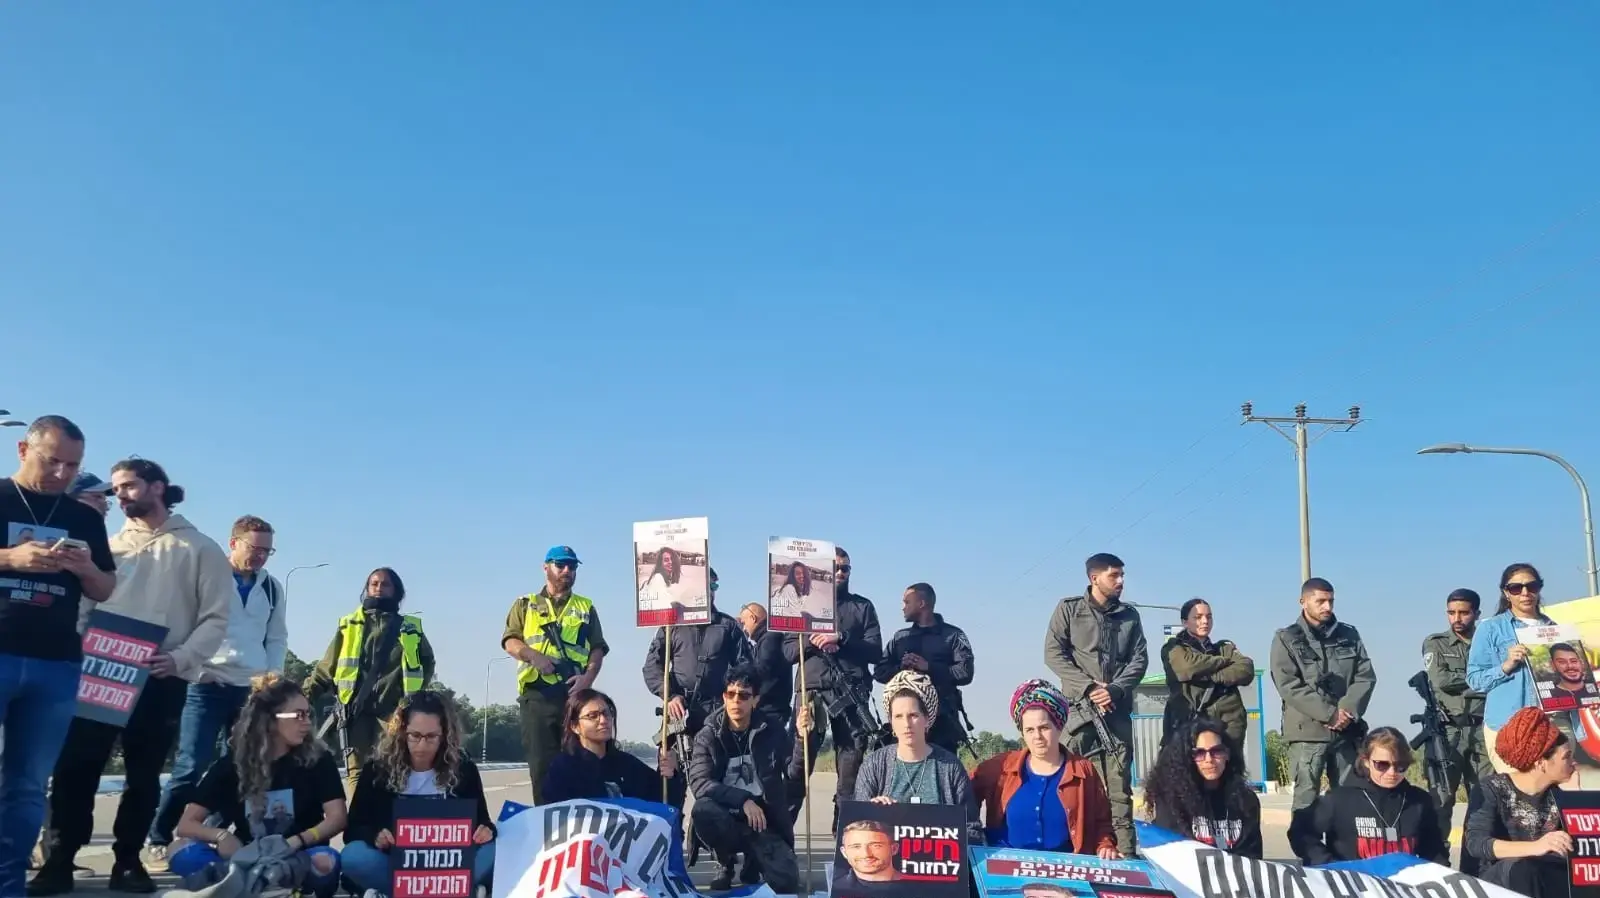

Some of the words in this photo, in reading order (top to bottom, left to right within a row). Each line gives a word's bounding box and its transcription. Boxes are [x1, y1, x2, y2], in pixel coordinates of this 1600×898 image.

[86, 632, 154, 662] הומניטרי
[82, 655, 138, 683] תמורת
[78, 680, 133, 708] הומניט
[399, 824, 469, 843] הומניטרי
[544, 805, 648, 863] אותם
[894, 825, 959, 841] אבינתן
[403, 849, 463, 868] תמורת
[901, 839, 960, 861] חיין
[901, 859, 960, 876] לחזור!
[1012, 868, 1087, 881] אבינתן
[1020, 861, 1112, 875] ומחזירים
[1574, 863, 1600, 881] טרי
[396, 875, 467, 895] הומניטרי
[1094, 874, 1127, 885] את
